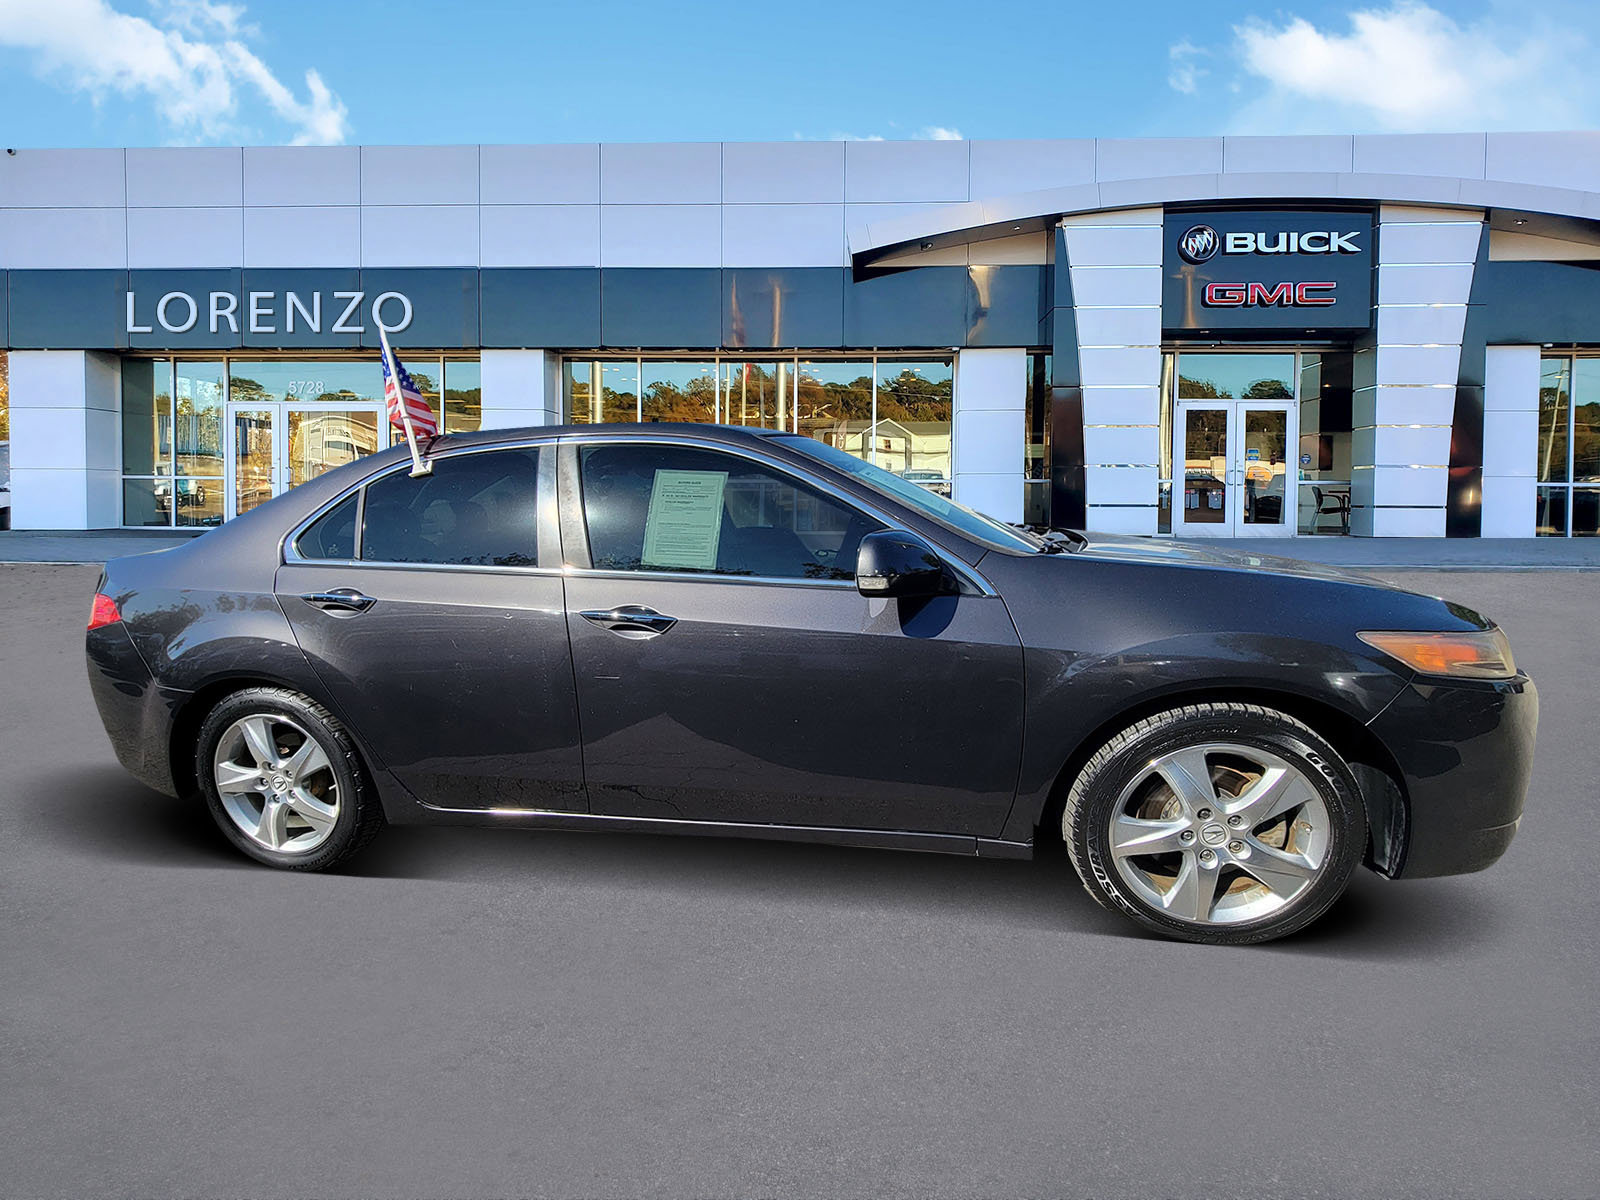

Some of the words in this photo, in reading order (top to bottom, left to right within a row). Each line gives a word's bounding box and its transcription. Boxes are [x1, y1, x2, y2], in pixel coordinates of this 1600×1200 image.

[1225, 231, 1362, 253] BUICK
[1205, 282, 1336, 305] GMC
[126, 291, 413, 333] LORENZO
[288, 380, 325, 394] 5728
